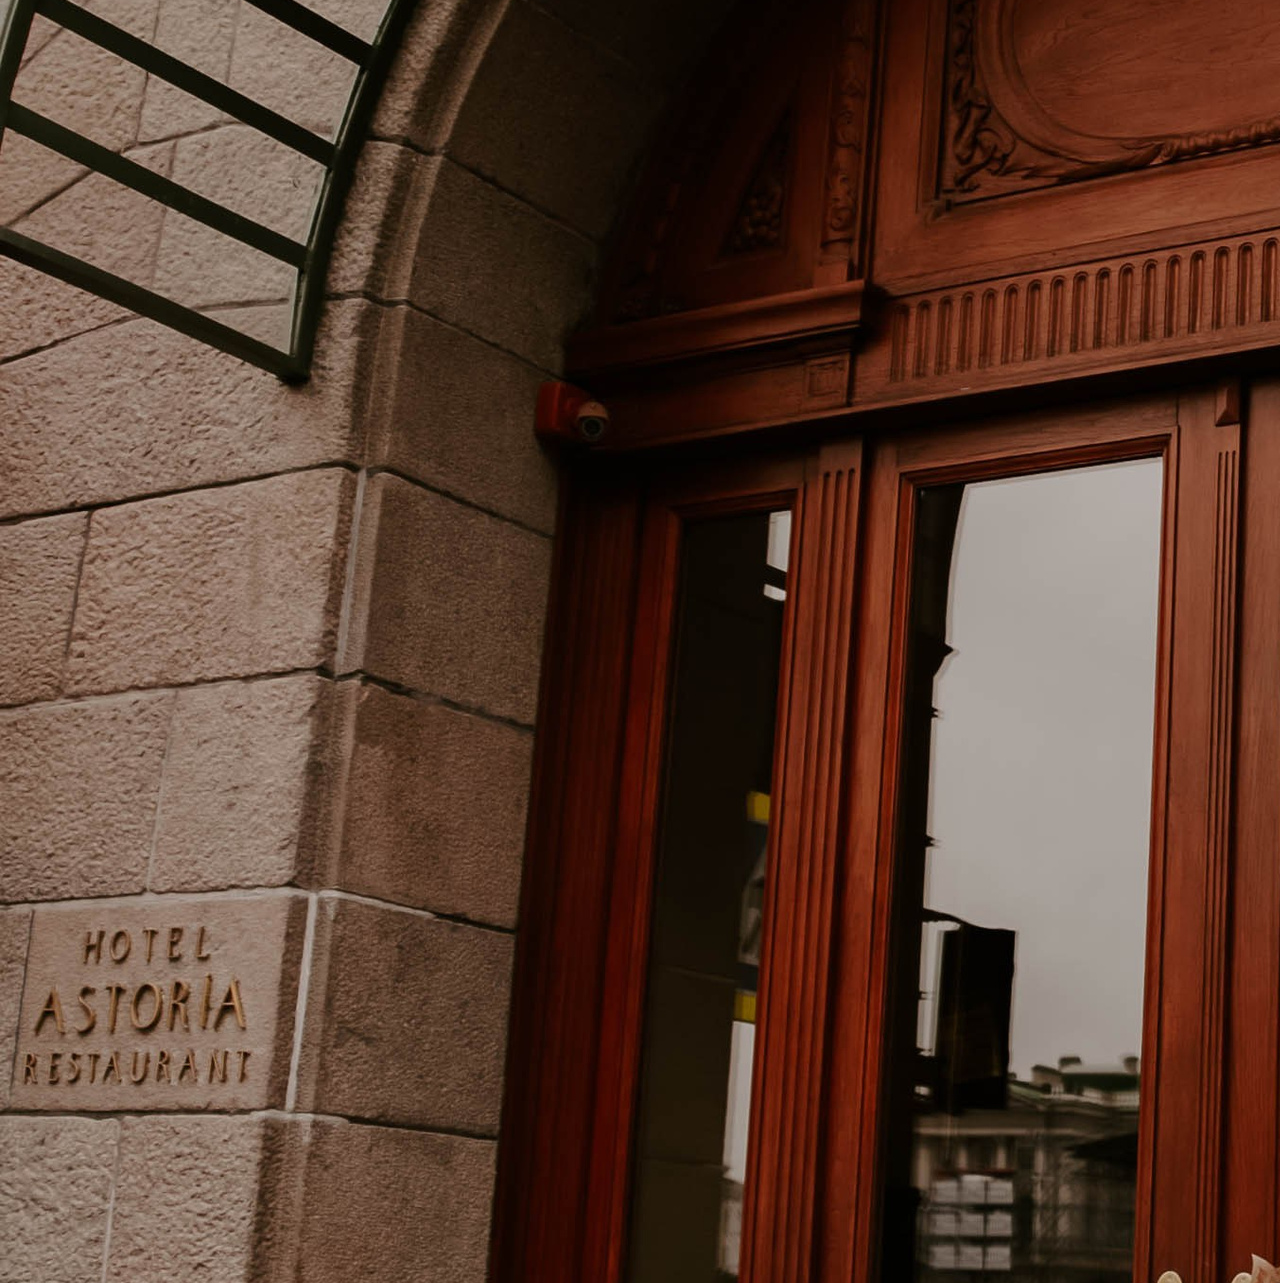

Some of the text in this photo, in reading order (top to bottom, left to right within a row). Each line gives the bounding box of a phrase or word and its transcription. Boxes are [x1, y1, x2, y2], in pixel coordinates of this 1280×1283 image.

[84, 926, 211, 965] HOTEL
[34, 973, 247, 1036] ASTORIA
[23, 1049, 251, 1085] RESTAURANT
